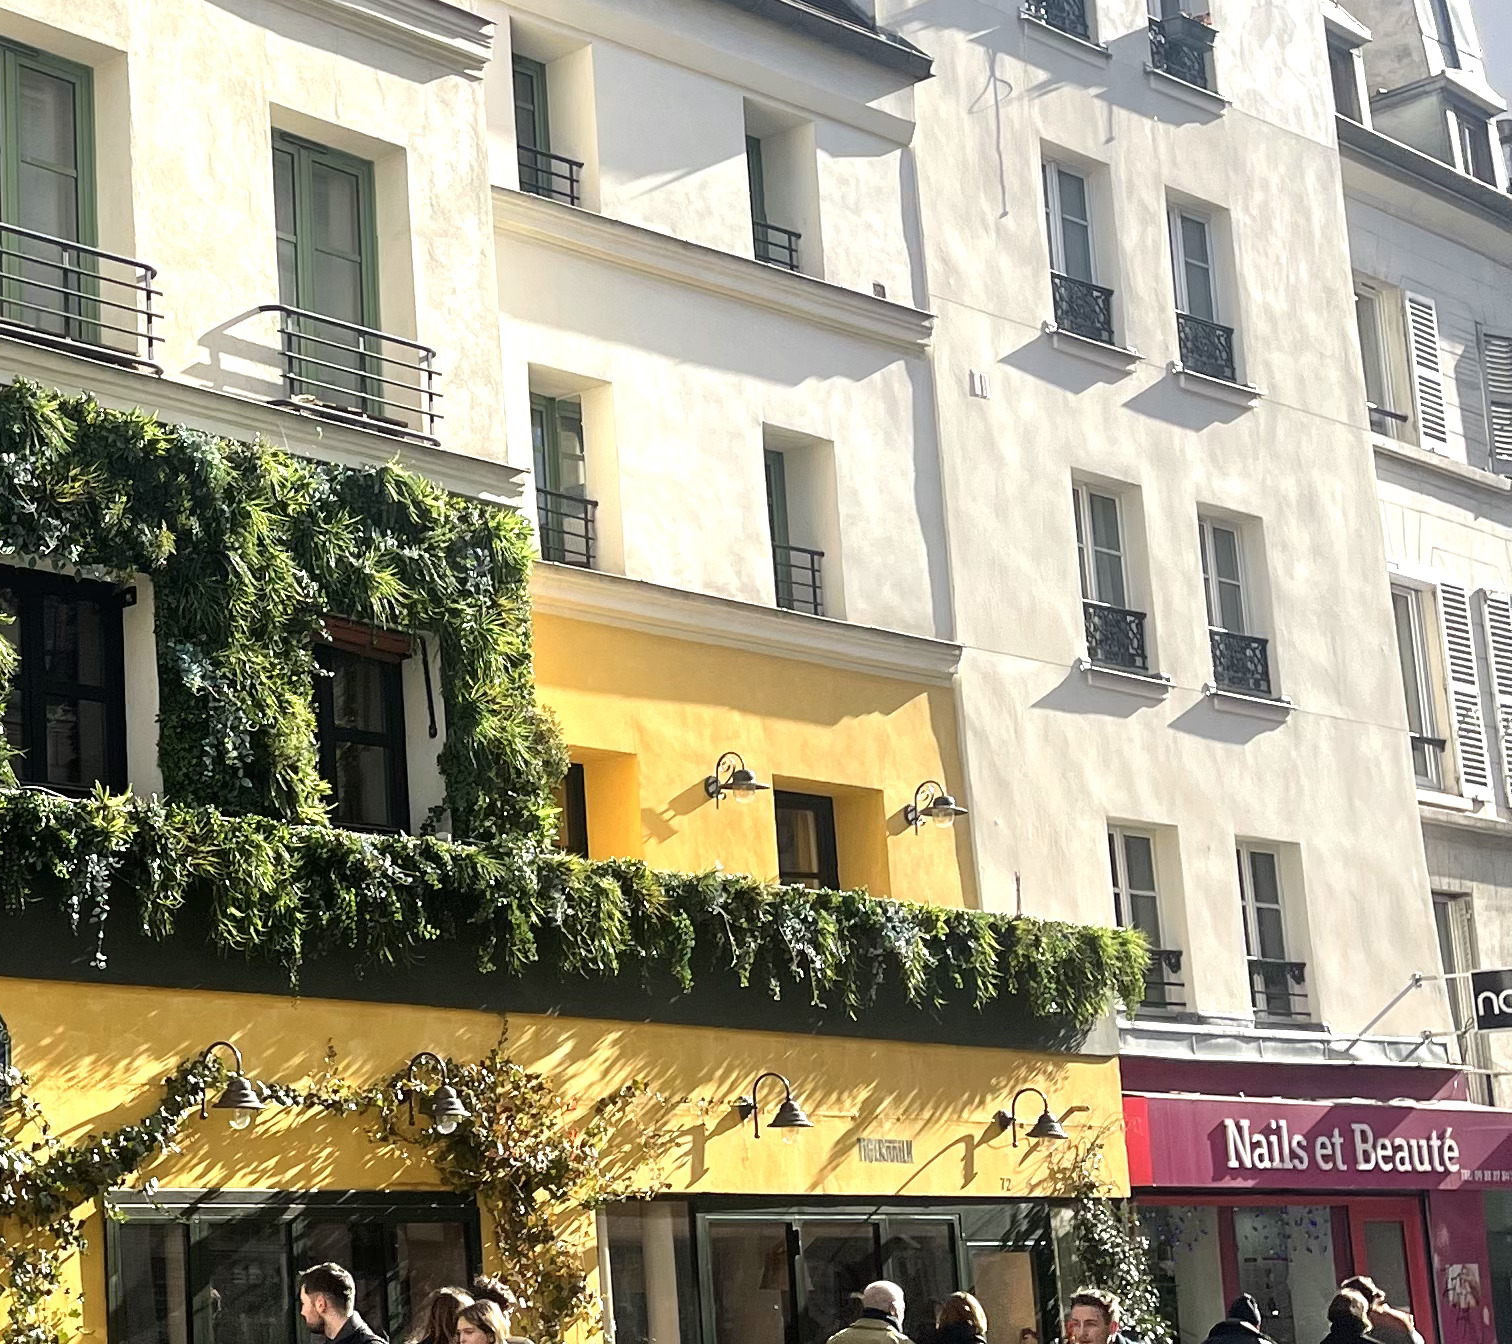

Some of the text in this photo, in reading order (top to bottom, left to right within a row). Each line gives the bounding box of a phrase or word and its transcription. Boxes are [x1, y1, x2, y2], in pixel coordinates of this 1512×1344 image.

[1223, 1117, 1461, 1174] Nails et Beauté
[999, 1177, 1012, 1192] 72
